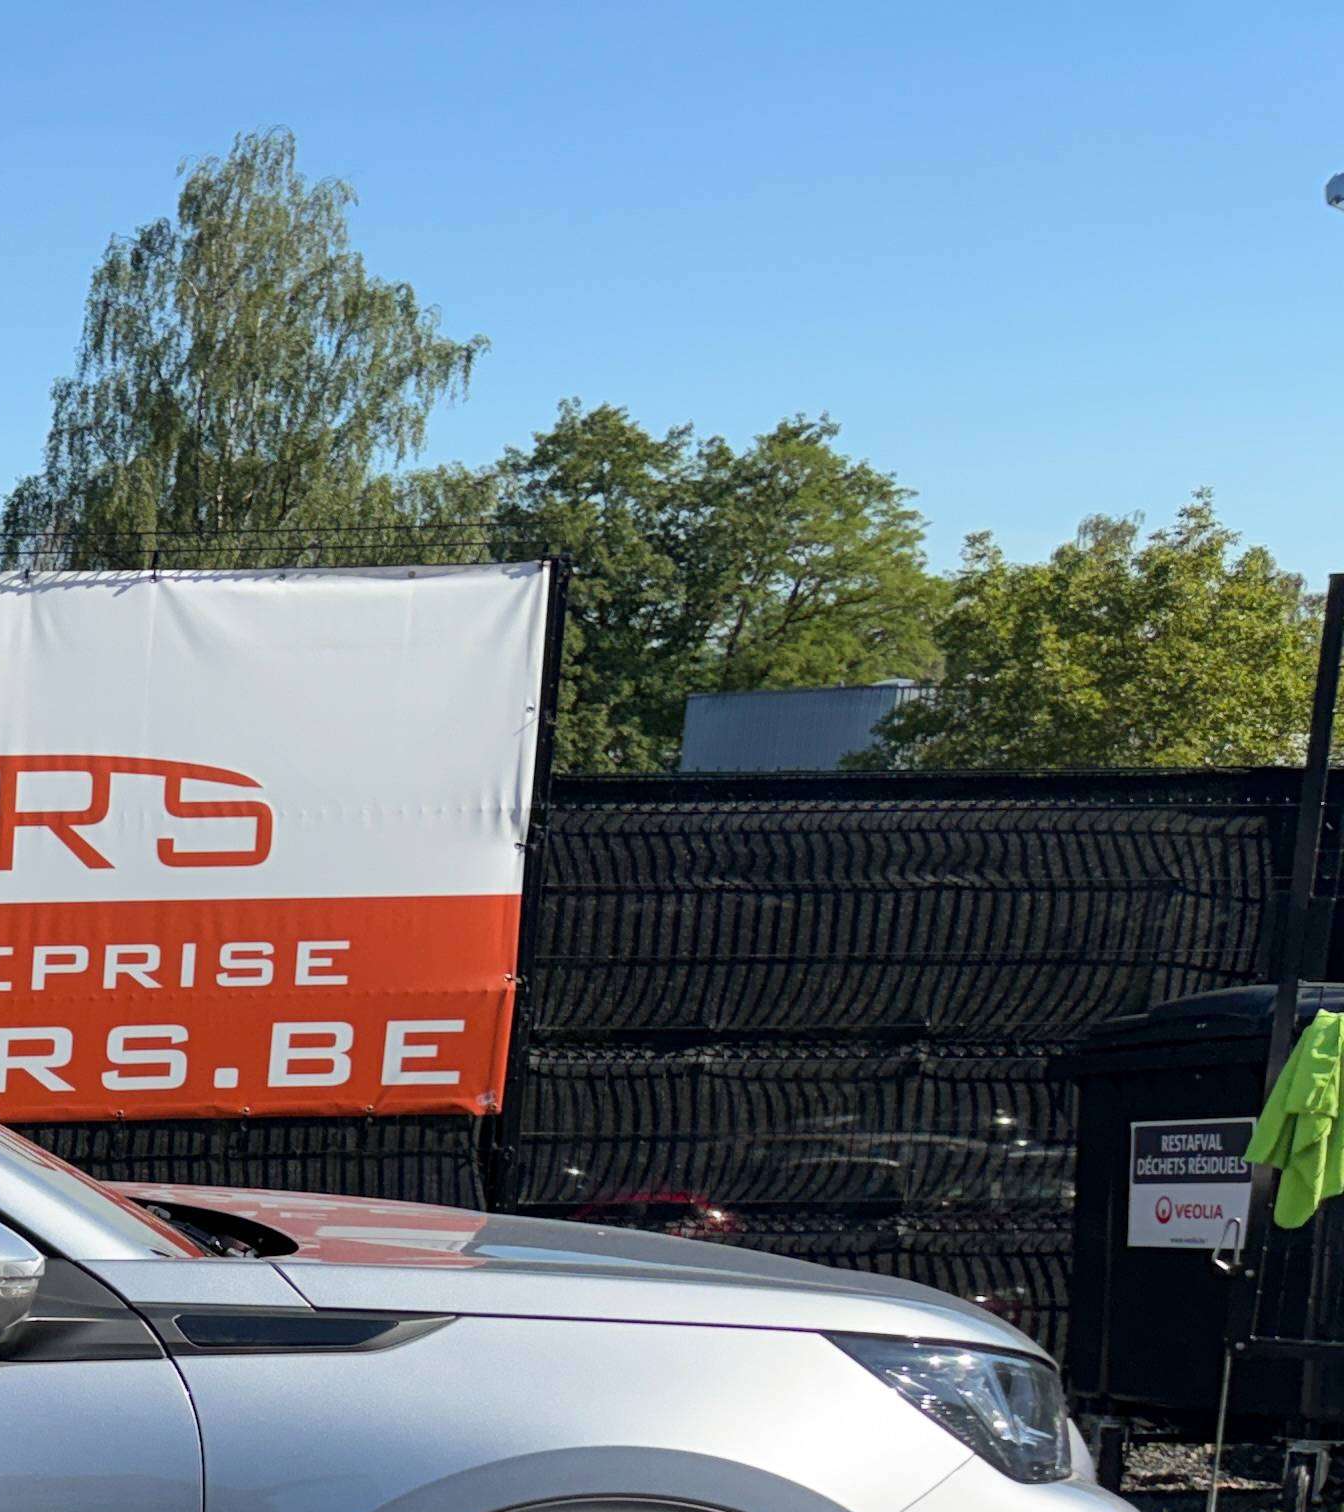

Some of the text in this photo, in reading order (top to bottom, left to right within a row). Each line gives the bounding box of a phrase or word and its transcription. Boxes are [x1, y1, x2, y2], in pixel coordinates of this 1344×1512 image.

[1161, 1134, 1223, 1152] RESTAFVAL
[1137, 1154, 1247, 1175] DÉCHETS RÉSIDUELS
[1175, 1204, 1223, 1219] VEOLIA
